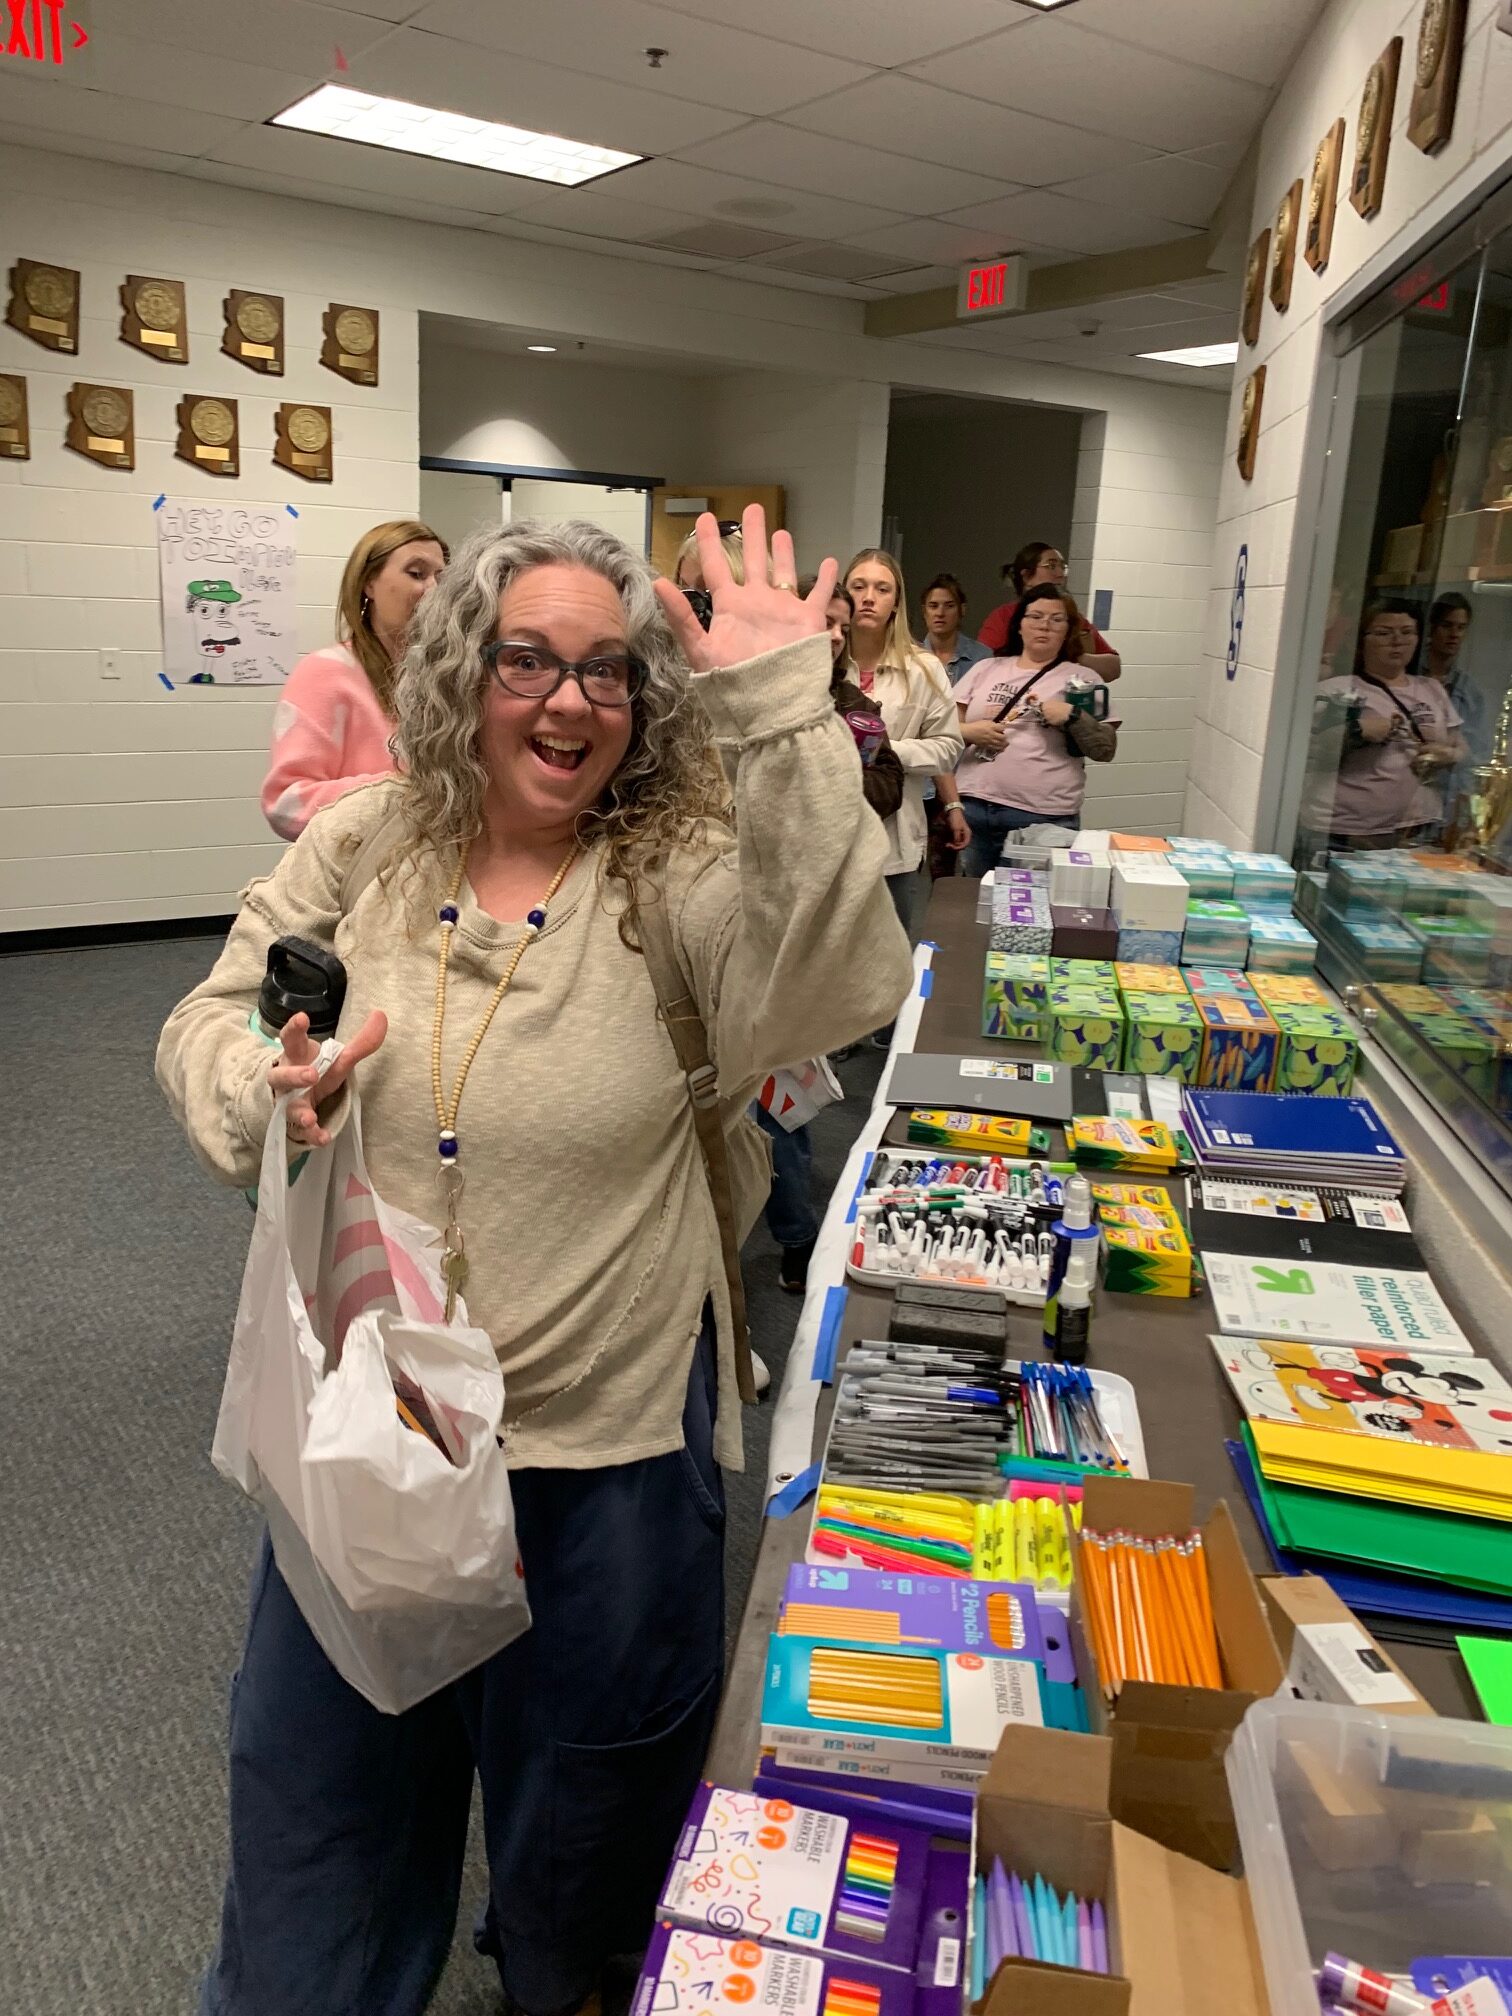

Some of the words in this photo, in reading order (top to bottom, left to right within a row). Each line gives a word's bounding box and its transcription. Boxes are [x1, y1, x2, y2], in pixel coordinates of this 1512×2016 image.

[0, 0, 64, 65] XIT
[967, 263, 1008, 310] EXIT
[160, 507, 223, 536] HEY
[228, 510, 279, 539] GO
[1352, 1275, 1378, 1302] filler
[1380, 1277, 1431, 1340] reinforced
[1404, 1279, 1440, 1307] quad
[1422, 1308, 1458, 1336] ruled
[1361, 1304, 1398, 1342] paper
[962, 1598, 984, 1645] Pencils
[993, 1660, 1005, 1682] WOOD
[1006, 1661, 1025, 1718] UNSHARPENED
[995, 1683, 1010, 1714] PENCILS
[794, 1812, 815, 1853] MARKERS
[807, 1815, 829, 1863] WASHABLE
[764, 1953, 786, 2006] MARKERS
[780, 1957, 802, 2016] WASHABLE
